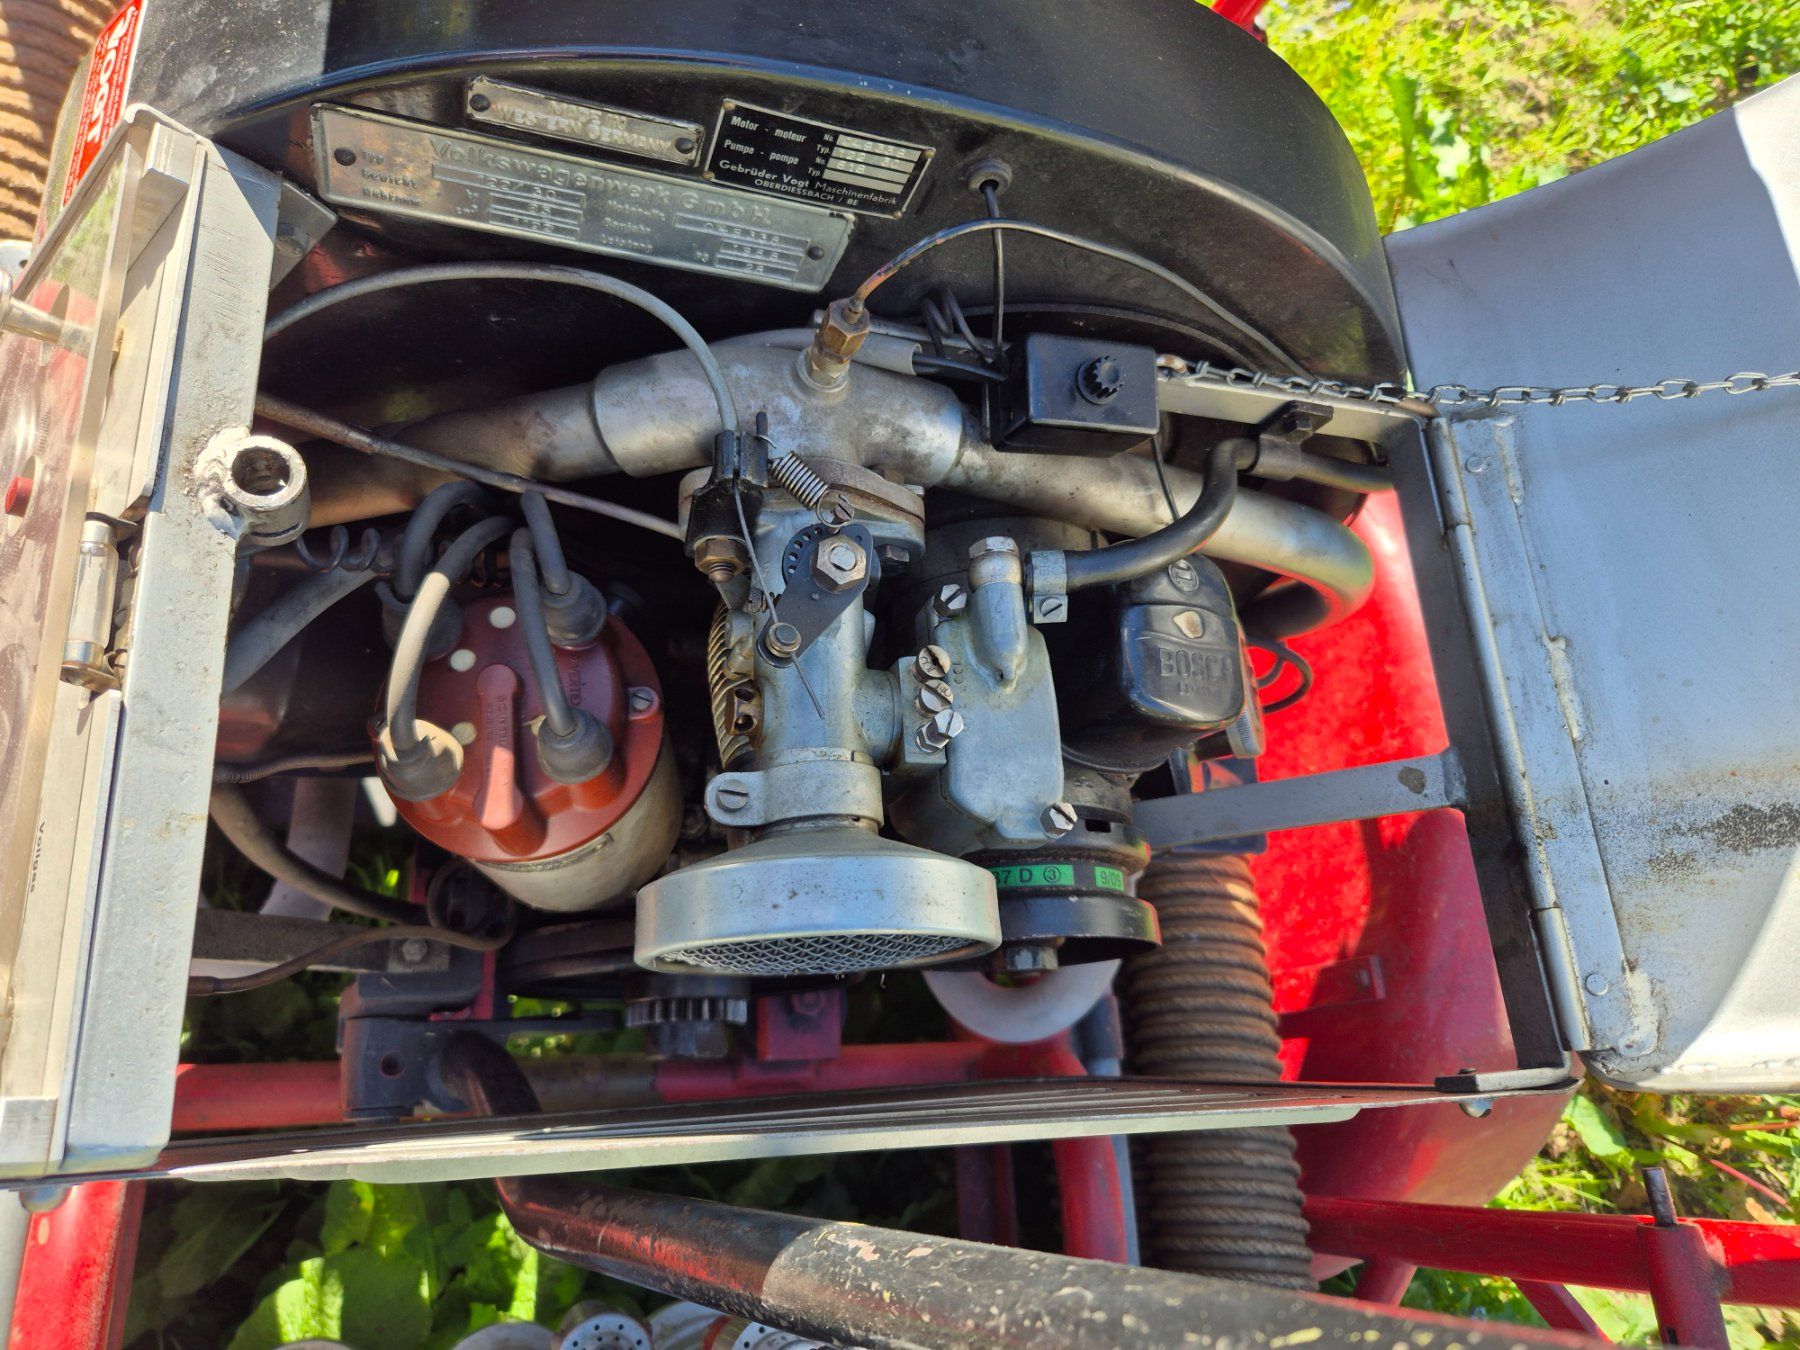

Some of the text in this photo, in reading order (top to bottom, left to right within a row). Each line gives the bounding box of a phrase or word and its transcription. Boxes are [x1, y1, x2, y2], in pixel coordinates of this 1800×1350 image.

[496, 103, 672, 151] WESTERN GERMANY
[549, 100, 627, 130] MADE IN
[730, 115, 759, 131] Motor
[775, 128, 807, 143] moteur
[724, 139, 755, 155] Pumpe
[769, 151, 800, 165] pompe
[430, 138, 771, 226] Volkswagenwerk GmbH
[719, 159, 898, 206] Gebrüder Vogt Maschinenfabrik
[754, 178, 835, 202] OBERDIESSBACH
[846, 198, 859, 206] BE
[1159, 647, 1233, 683] BOSCH
[30, 820, 46, 894] Vollgas
[1019, 868, 1032, 883] D
[1101, 871, 1121, 887] 9/09
